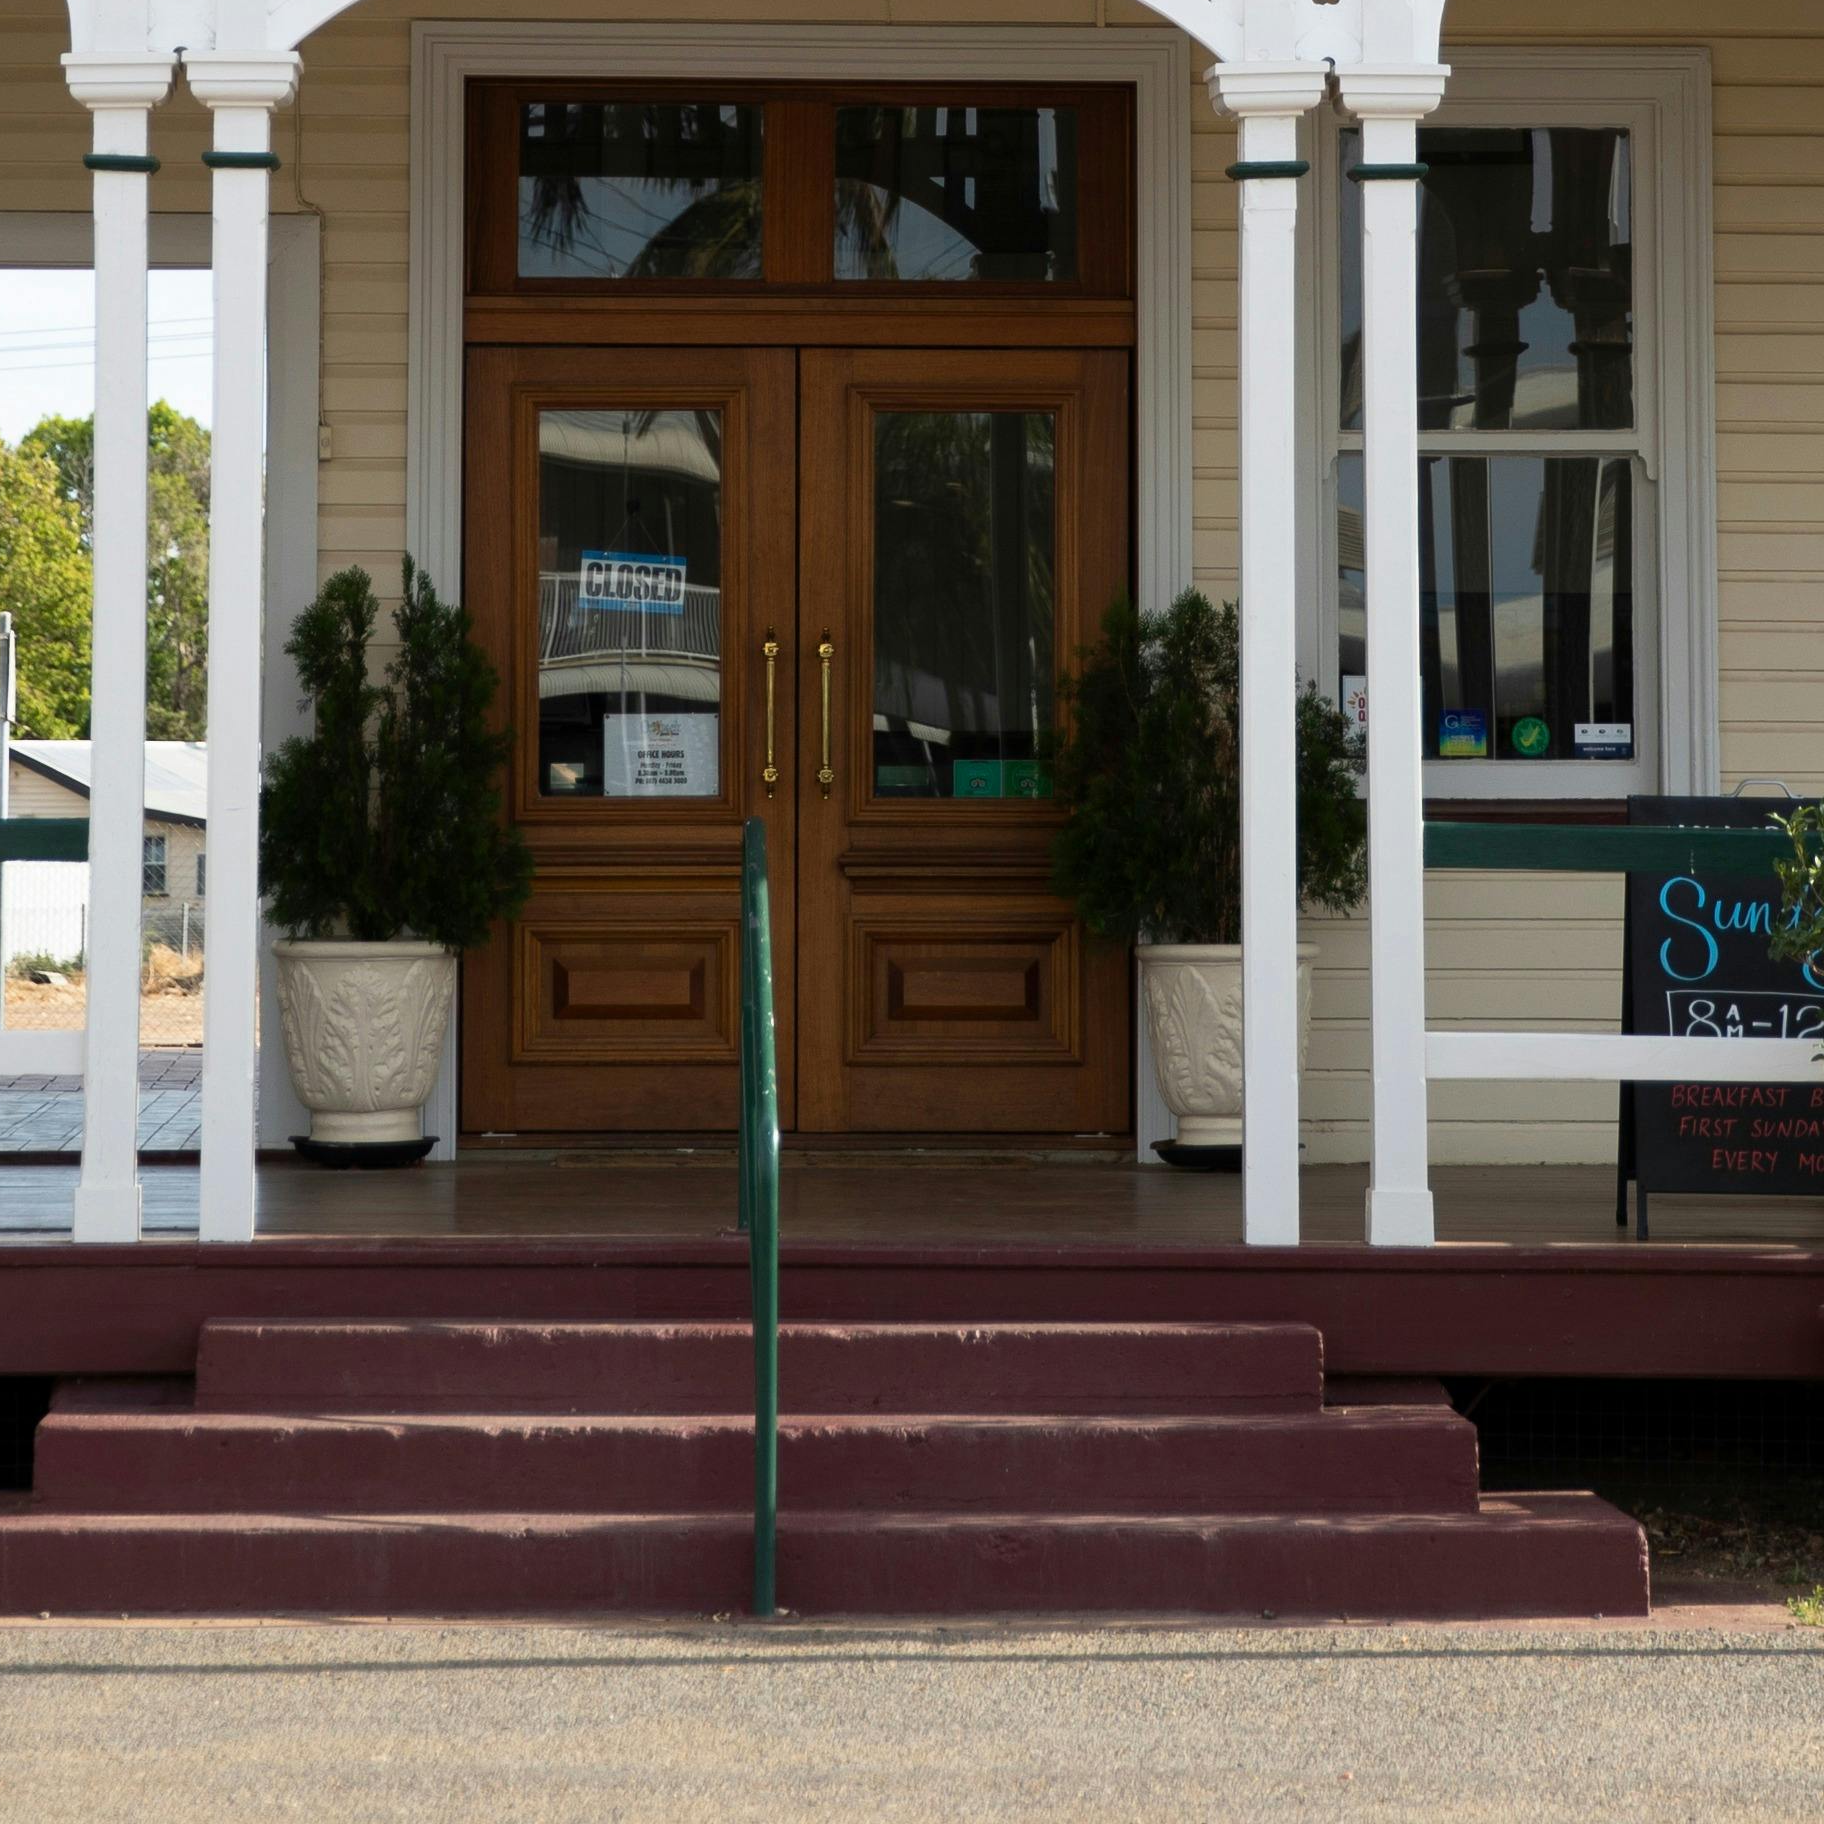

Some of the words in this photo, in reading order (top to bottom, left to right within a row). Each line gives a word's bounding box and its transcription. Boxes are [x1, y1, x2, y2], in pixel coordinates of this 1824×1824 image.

[585, 561, 682, 602] CLOSED
[637, 750, 659, 759] OFFICE
[661, 750, 685, 759] HOURS
[1671, 1084, 1791, 1108] BREAKFAST
[1679, 1115, 1738, 1138] FIRST
[1712, 1148, 1779, 1173] EVERY
